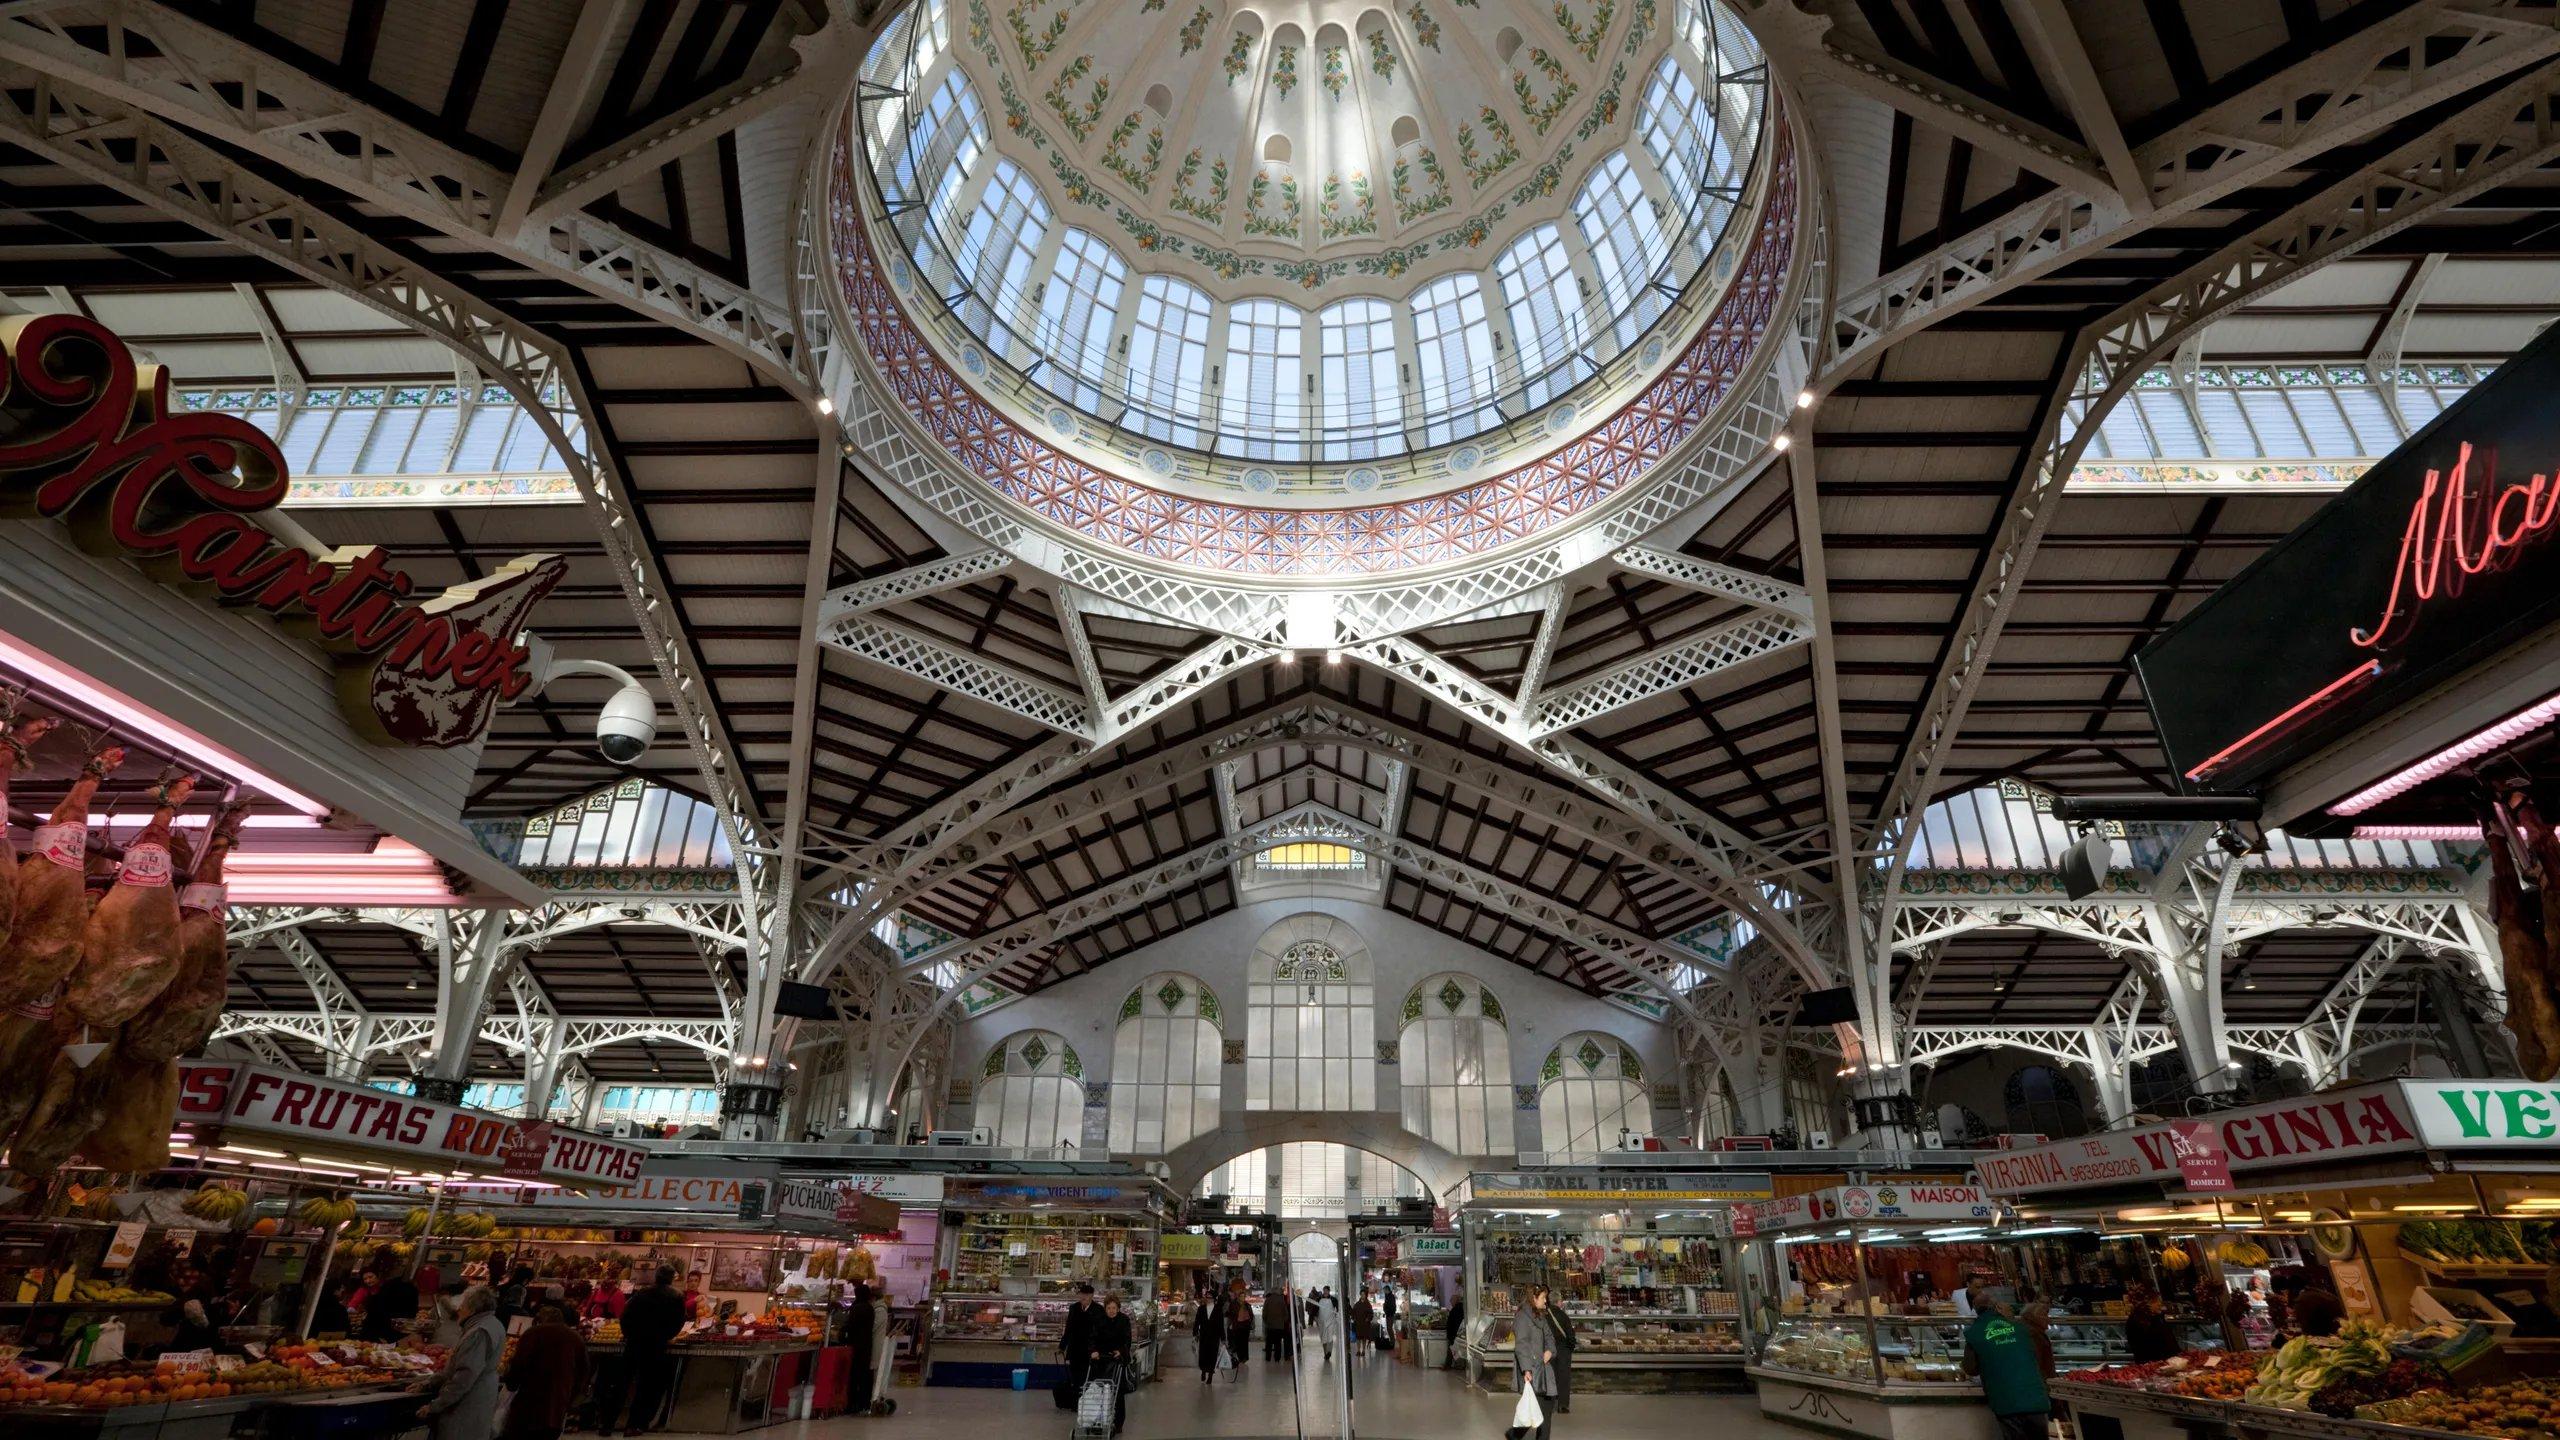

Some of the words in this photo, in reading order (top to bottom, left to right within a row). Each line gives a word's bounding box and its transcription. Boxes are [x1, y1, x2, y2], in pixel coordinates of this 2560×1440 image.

[2349, 440, 2560, 648] Ma
[178, 1067, 233, 1113] S
[2437, 1089, 2560, 1138] VE
[234, 1073, 435, 1145] FRUTAS
[545, 1134, 646, 1180] RUTAS
[2132, 1094, 2414, 1171] VIGINIA
[2080, 1140, 2110, 1158] TEL:
[1978, 1151, 2067, 1190] VIRGINIA
[2069, 1158, 2141, 1182] 963829206
[2186, 1159, 2218, 1167] SERVICI
[1518, 1176, 1589, 1190] RAFAEL
[1598, 1176, 1669, 1190] FUSTER
[2190, 1178, 2226, 1187] DOMICILI
[781, 1183, 842, 1211] PUCHADE
[1047, 1186, 1089, 1198] VICENT
[1910, 1188, 1979, 1203] MAISON
[1161, 1240, 1201, 1253] natura
[1416, 1239, 1450, 1250] Rafael
[1453, 1239, 1462, 1249] C
